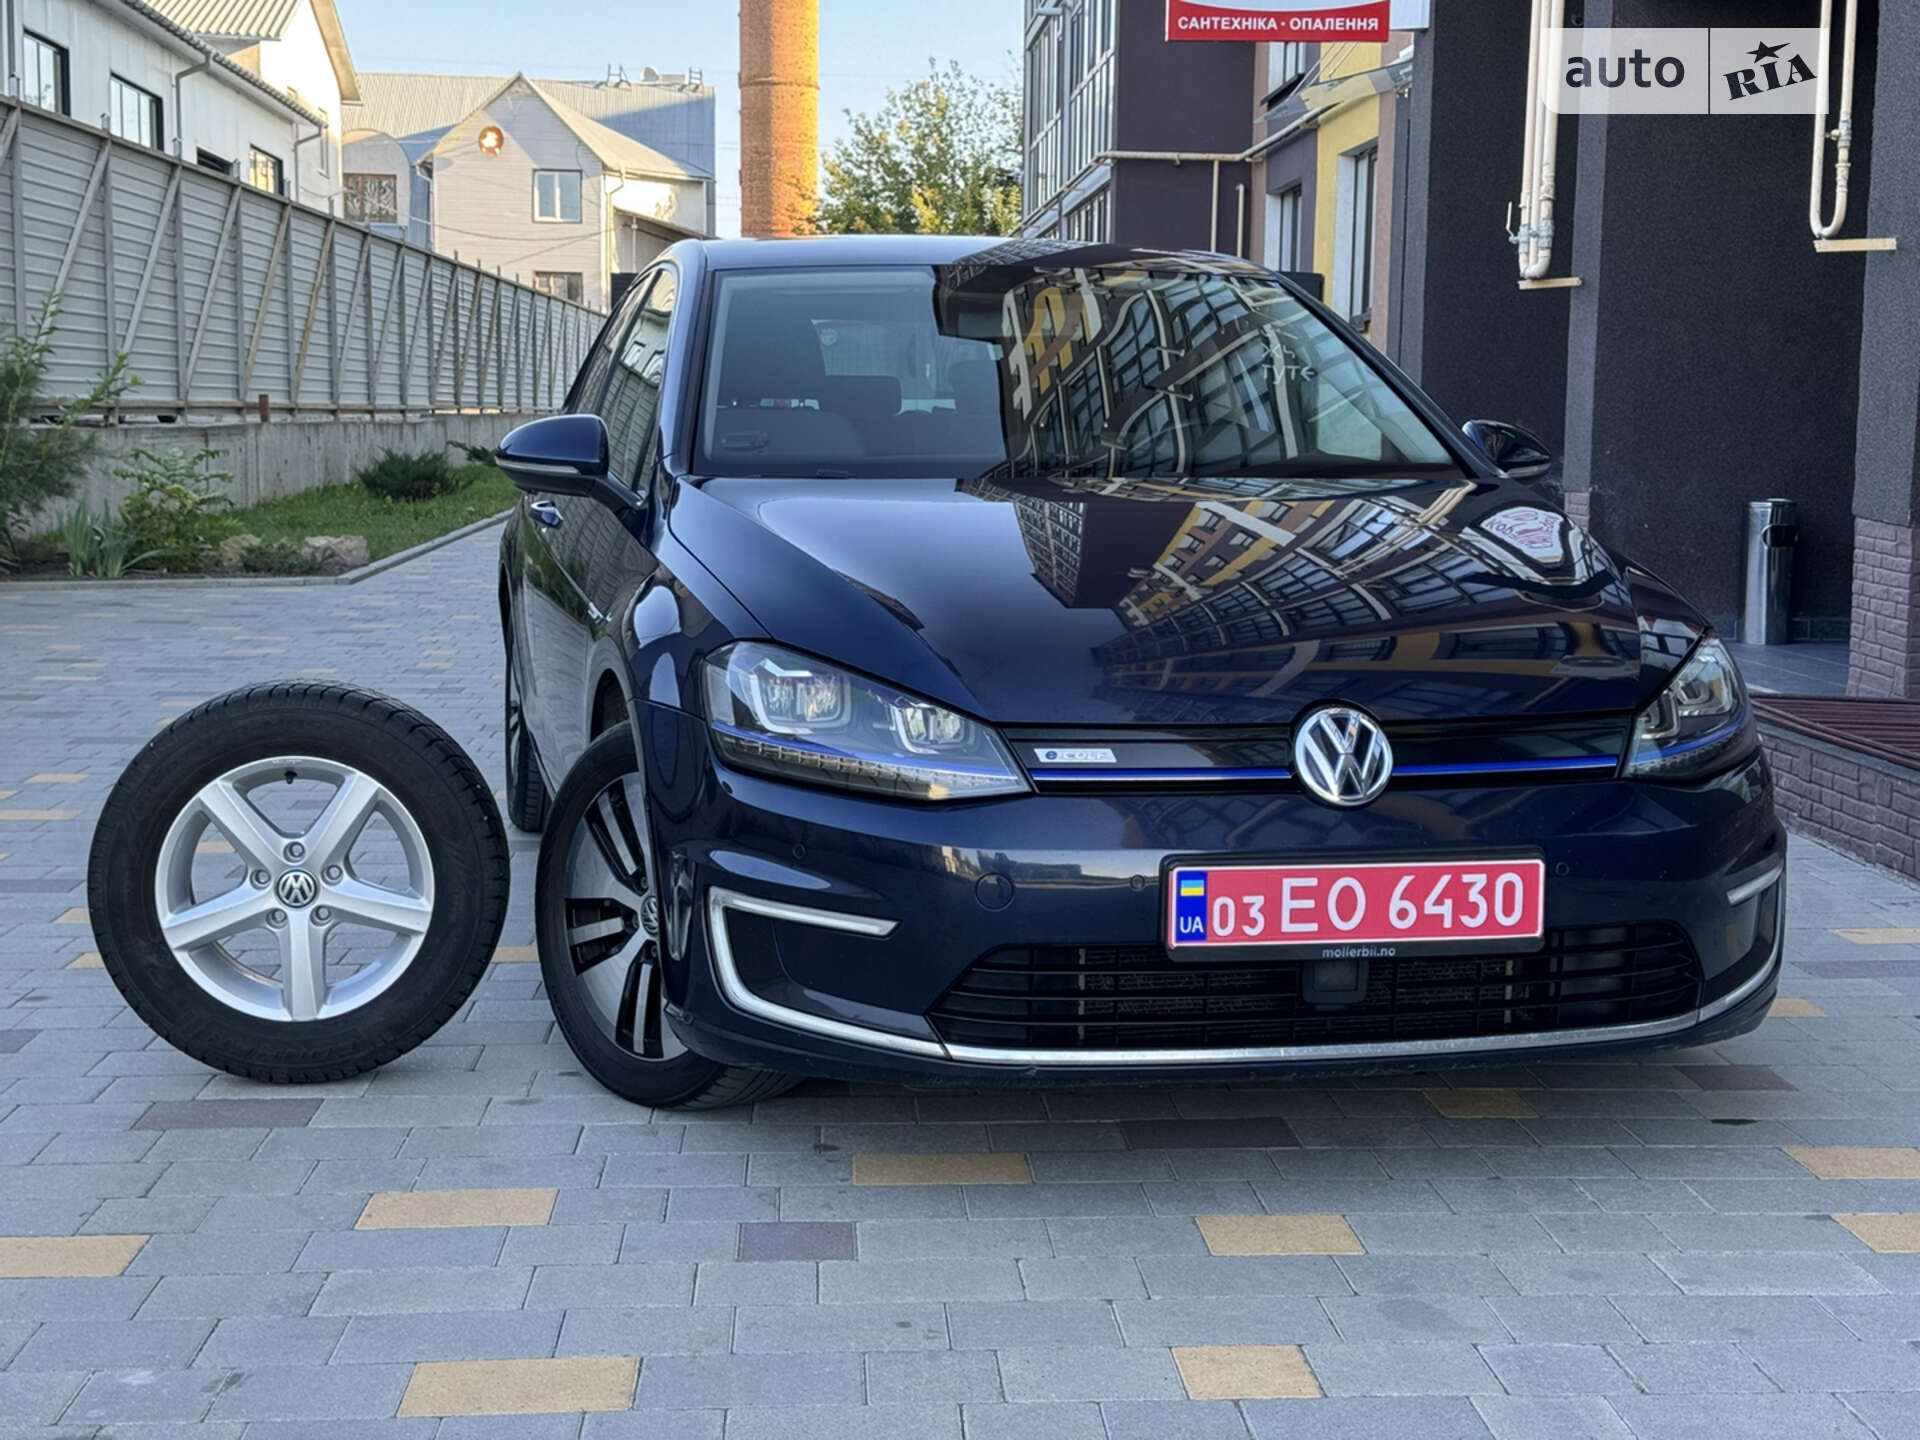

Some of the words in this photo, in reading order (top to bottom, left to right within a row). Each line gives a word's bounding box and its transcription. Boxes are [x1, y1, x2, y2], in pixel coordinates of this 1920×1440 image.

[1177, 16, 1278, 30] САНТЕХНІКА
[1289, 17, 1379, 31] ОПАЛЕННЯ
[1212, 895, 1265, 937] 03
[1281, 876, 1367, 933] EO
[1388, 871, 1525, 931] 6430
[1180, 916, 1204, 933] UA
